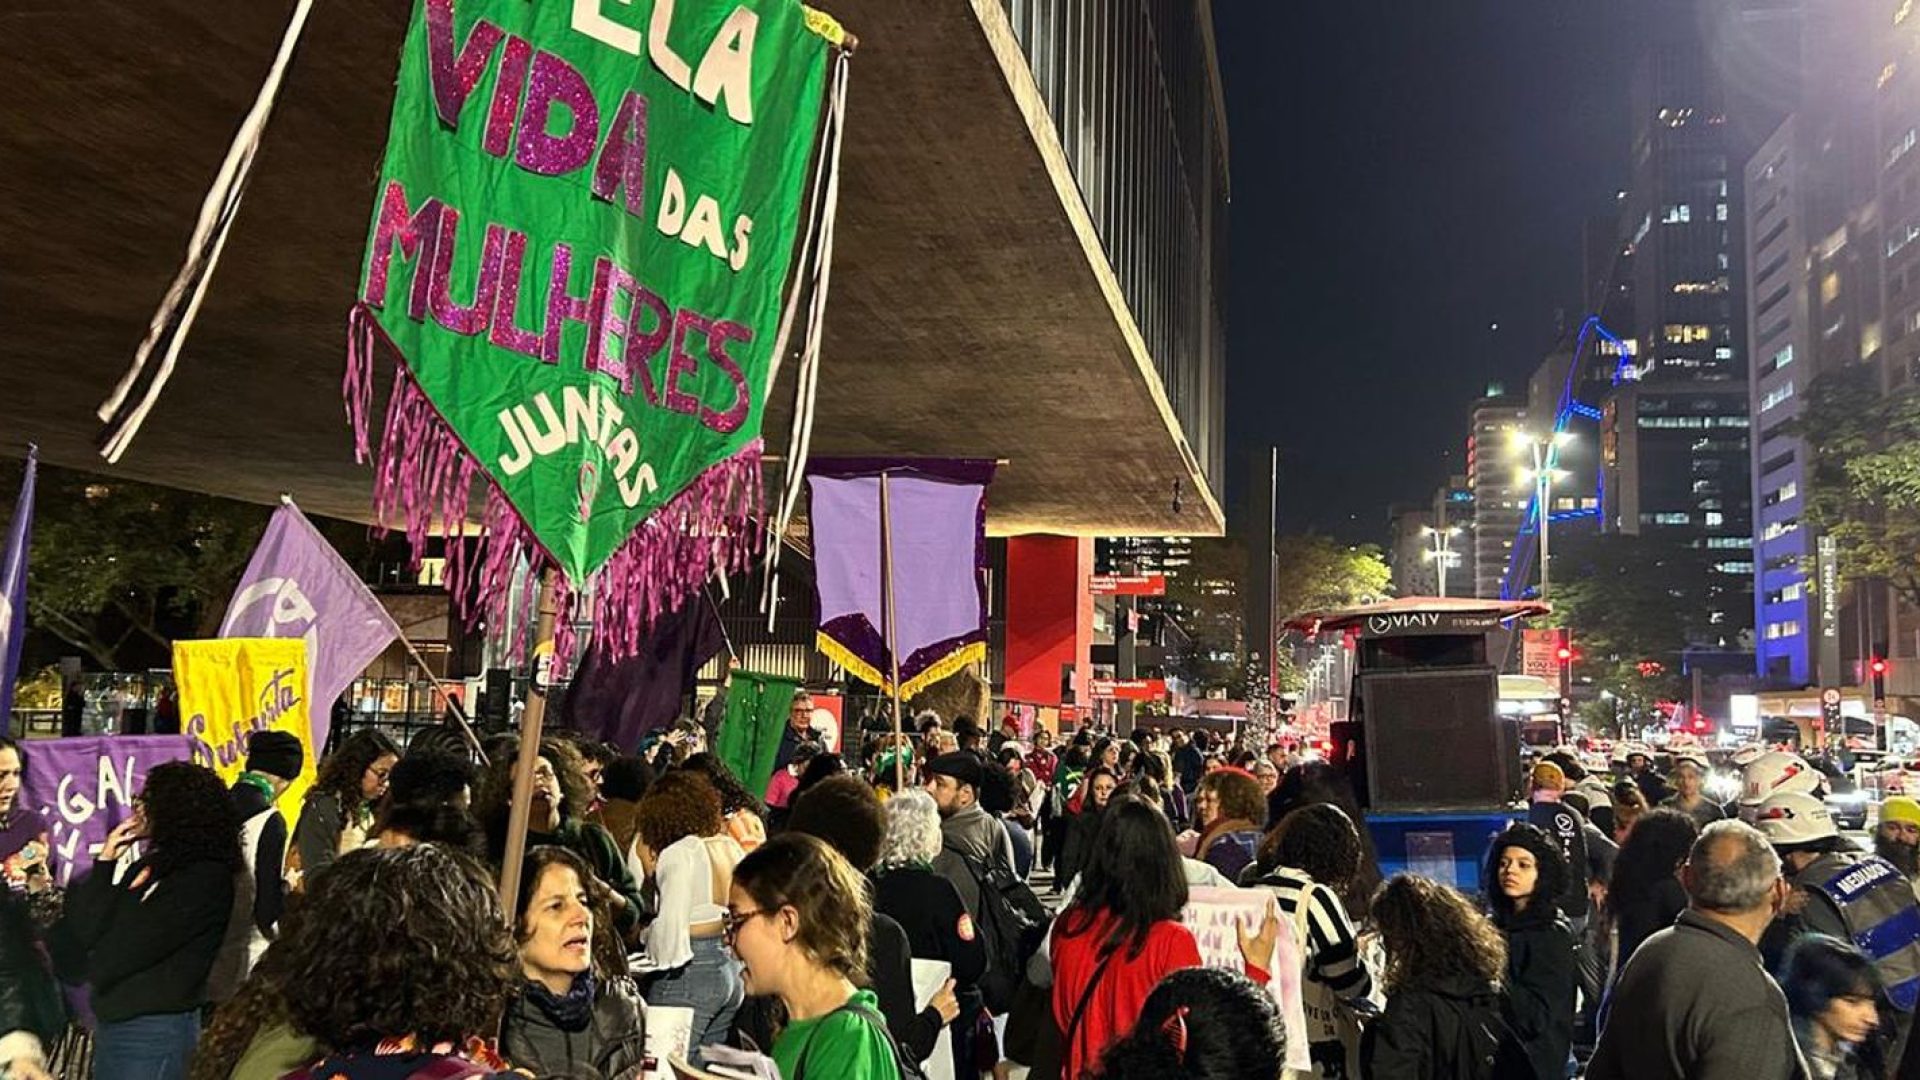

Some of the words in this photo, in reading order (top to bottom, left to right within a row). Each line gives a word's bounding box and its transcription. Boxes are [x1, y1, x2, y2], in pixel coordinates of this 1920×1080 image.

[426, 0, 648, 217] VIDA
[657, 168, 753, 272] DAS
[364, 180, 754, 433] MULHERES
[497, 385, 657, 507] JUNTAS
